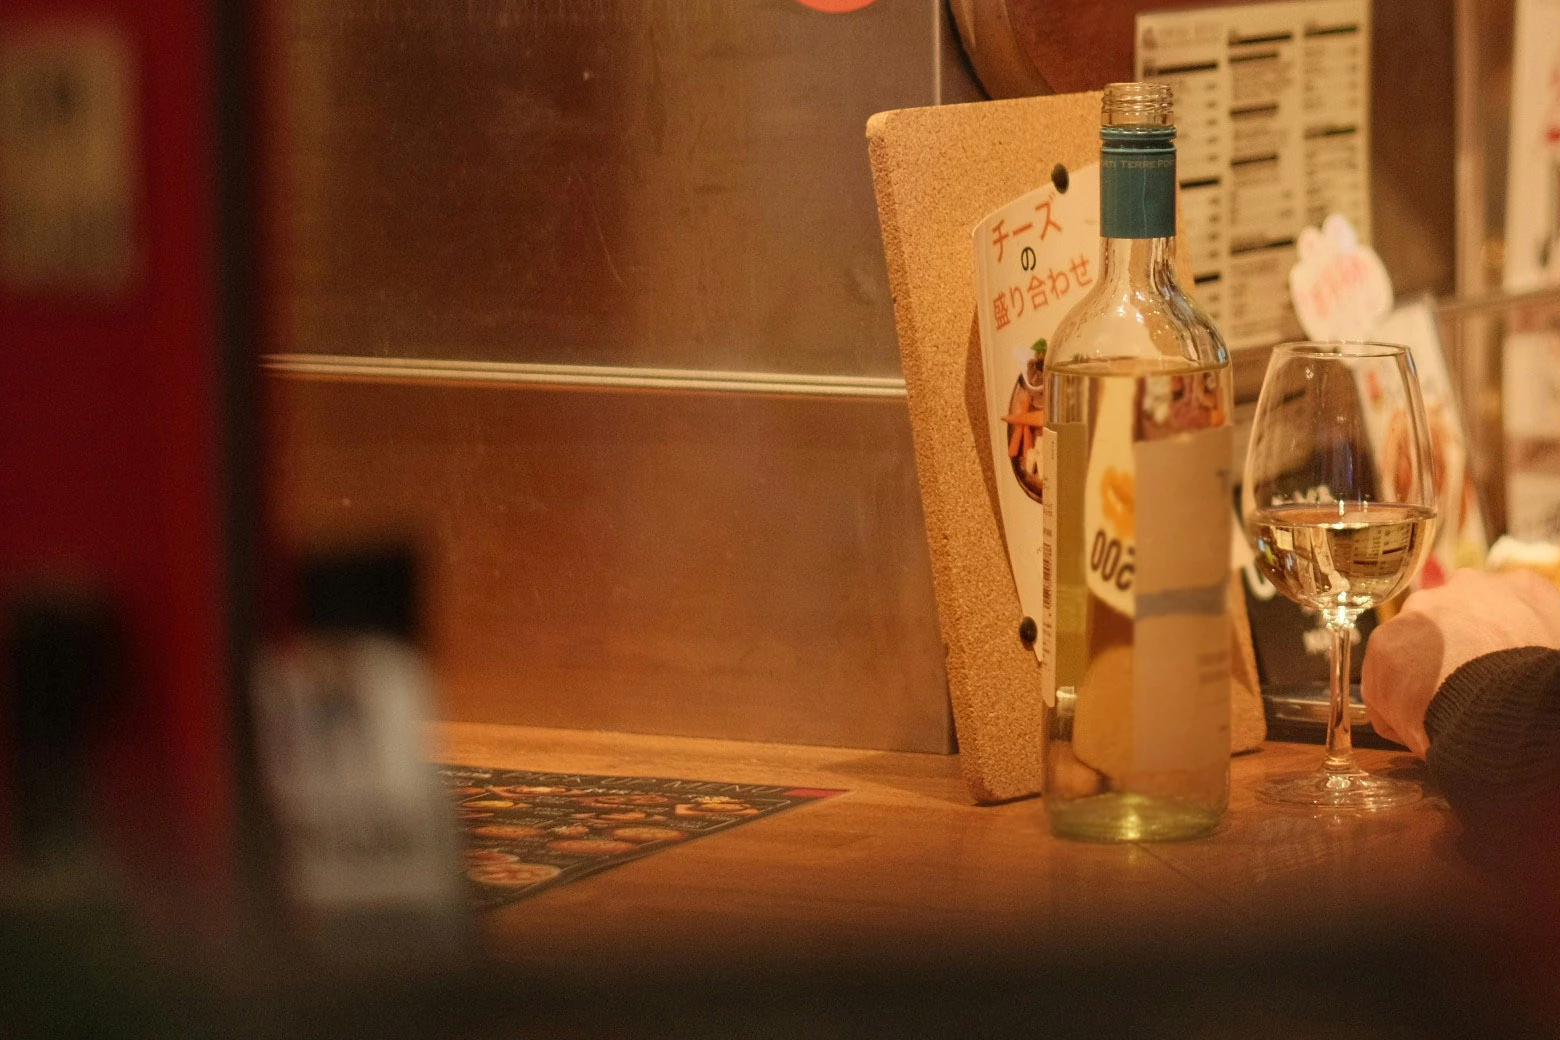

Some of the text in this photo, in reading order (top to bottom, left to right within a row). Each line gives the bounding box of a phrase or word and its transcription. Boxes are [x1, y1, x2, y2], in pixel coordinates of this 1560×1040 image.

[991, 191, 1062, 263] チーズ
[1021, 246, 1036, 271] の
[993, 254, 1093, 331] 盛り合わせ
